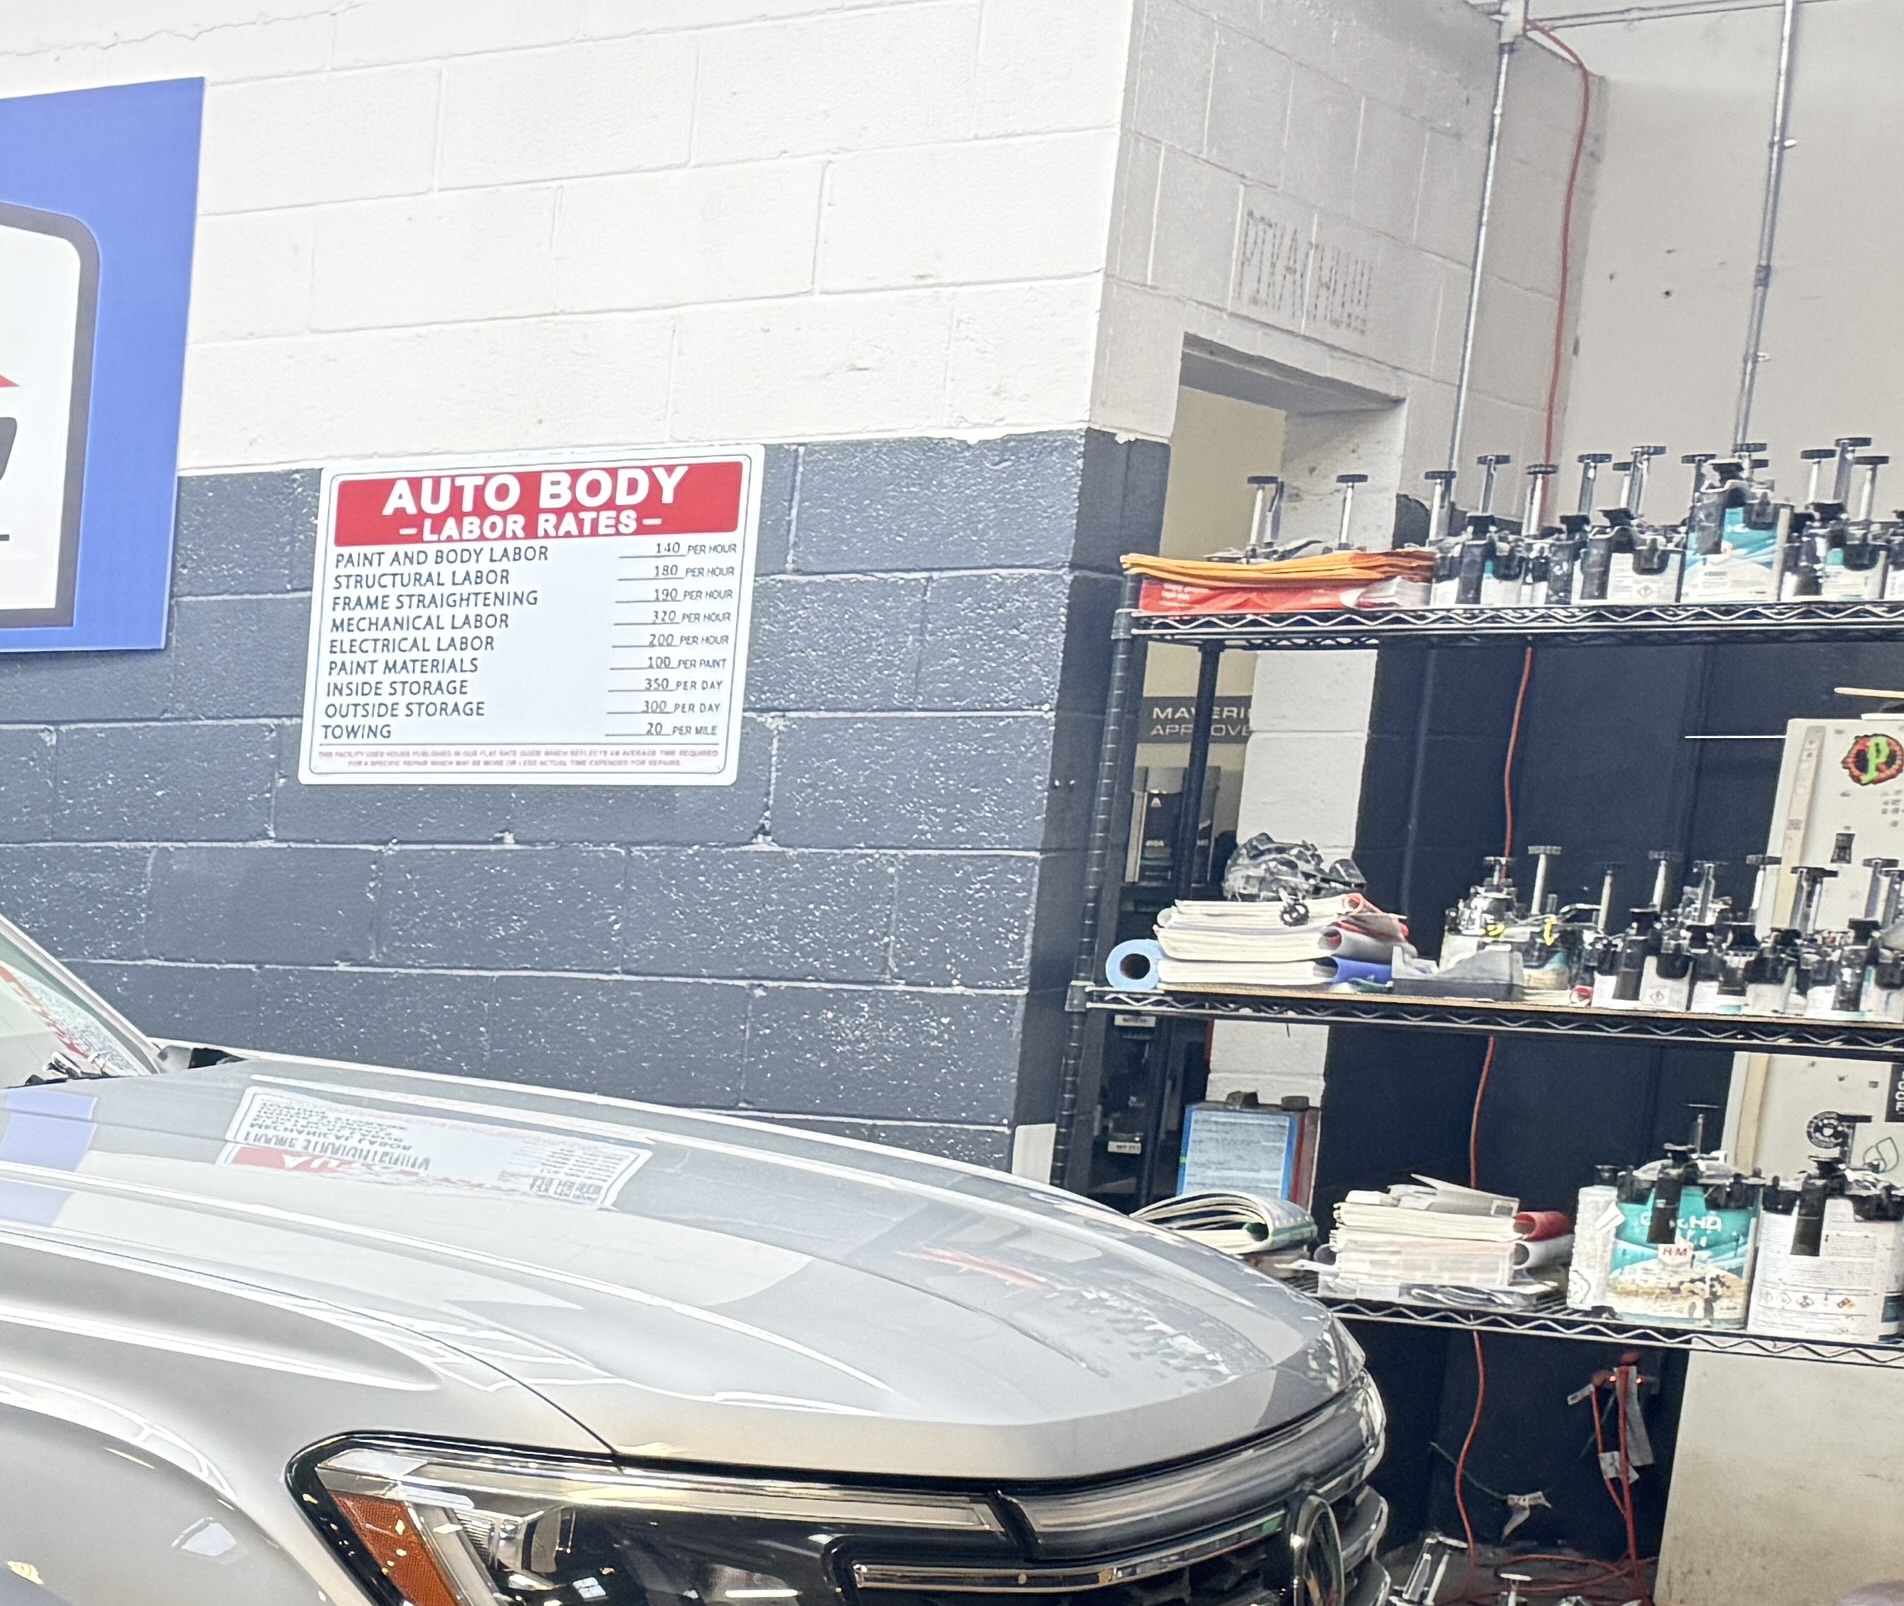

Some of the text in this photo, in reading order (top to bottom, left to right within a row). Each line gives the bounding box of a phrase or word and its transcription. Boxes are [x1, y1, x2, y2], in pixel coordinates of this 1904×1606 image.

[381, 465, 689, 516] AUTO BODY
[422, 509, 638, 542] LABOR RATES
[335, 541, 737, 569] PAINT AND BODY LABOR 140 PER HOUR
[333, 564, 735, 590] STRUCTURAL LABOR 180 PER HOUR
[331, 588, 733, 612] FRAME STRAIGHTENING 190 PER HOUR
[330, 615, 445, 633] MECHANICAL
[450, 613, 509, 630] LABOR
[681, 612, 701, 623] PER
[703, 611, 731, 622] HOUR
[329, 633, 729, 654] ELECTRICAL LABOR 200 PER HOUR
[328, 659, 378, 677] PAINT
[382, 657, 479, 676] MATERIALS
[647, 656, 672, 669] 100
[677, 658, 697, 669] PER
[326, 681, 383, 698] INSIDE
[388, 679, 469, 697] STORAGE
[675, 680, 697, 691] PER
[701, 680, 723, 690] DAY
[324, 702, 399, 719] OUTSIDE
[404, 701, 486, 718] STORAGE
[673, 702, 695, 714] PER
[699, 702, 721, 713] DAY
[1153, 706, 1250, 719] MAERI
[321, 722, 718, 740] TOWING 20 PER MILE
